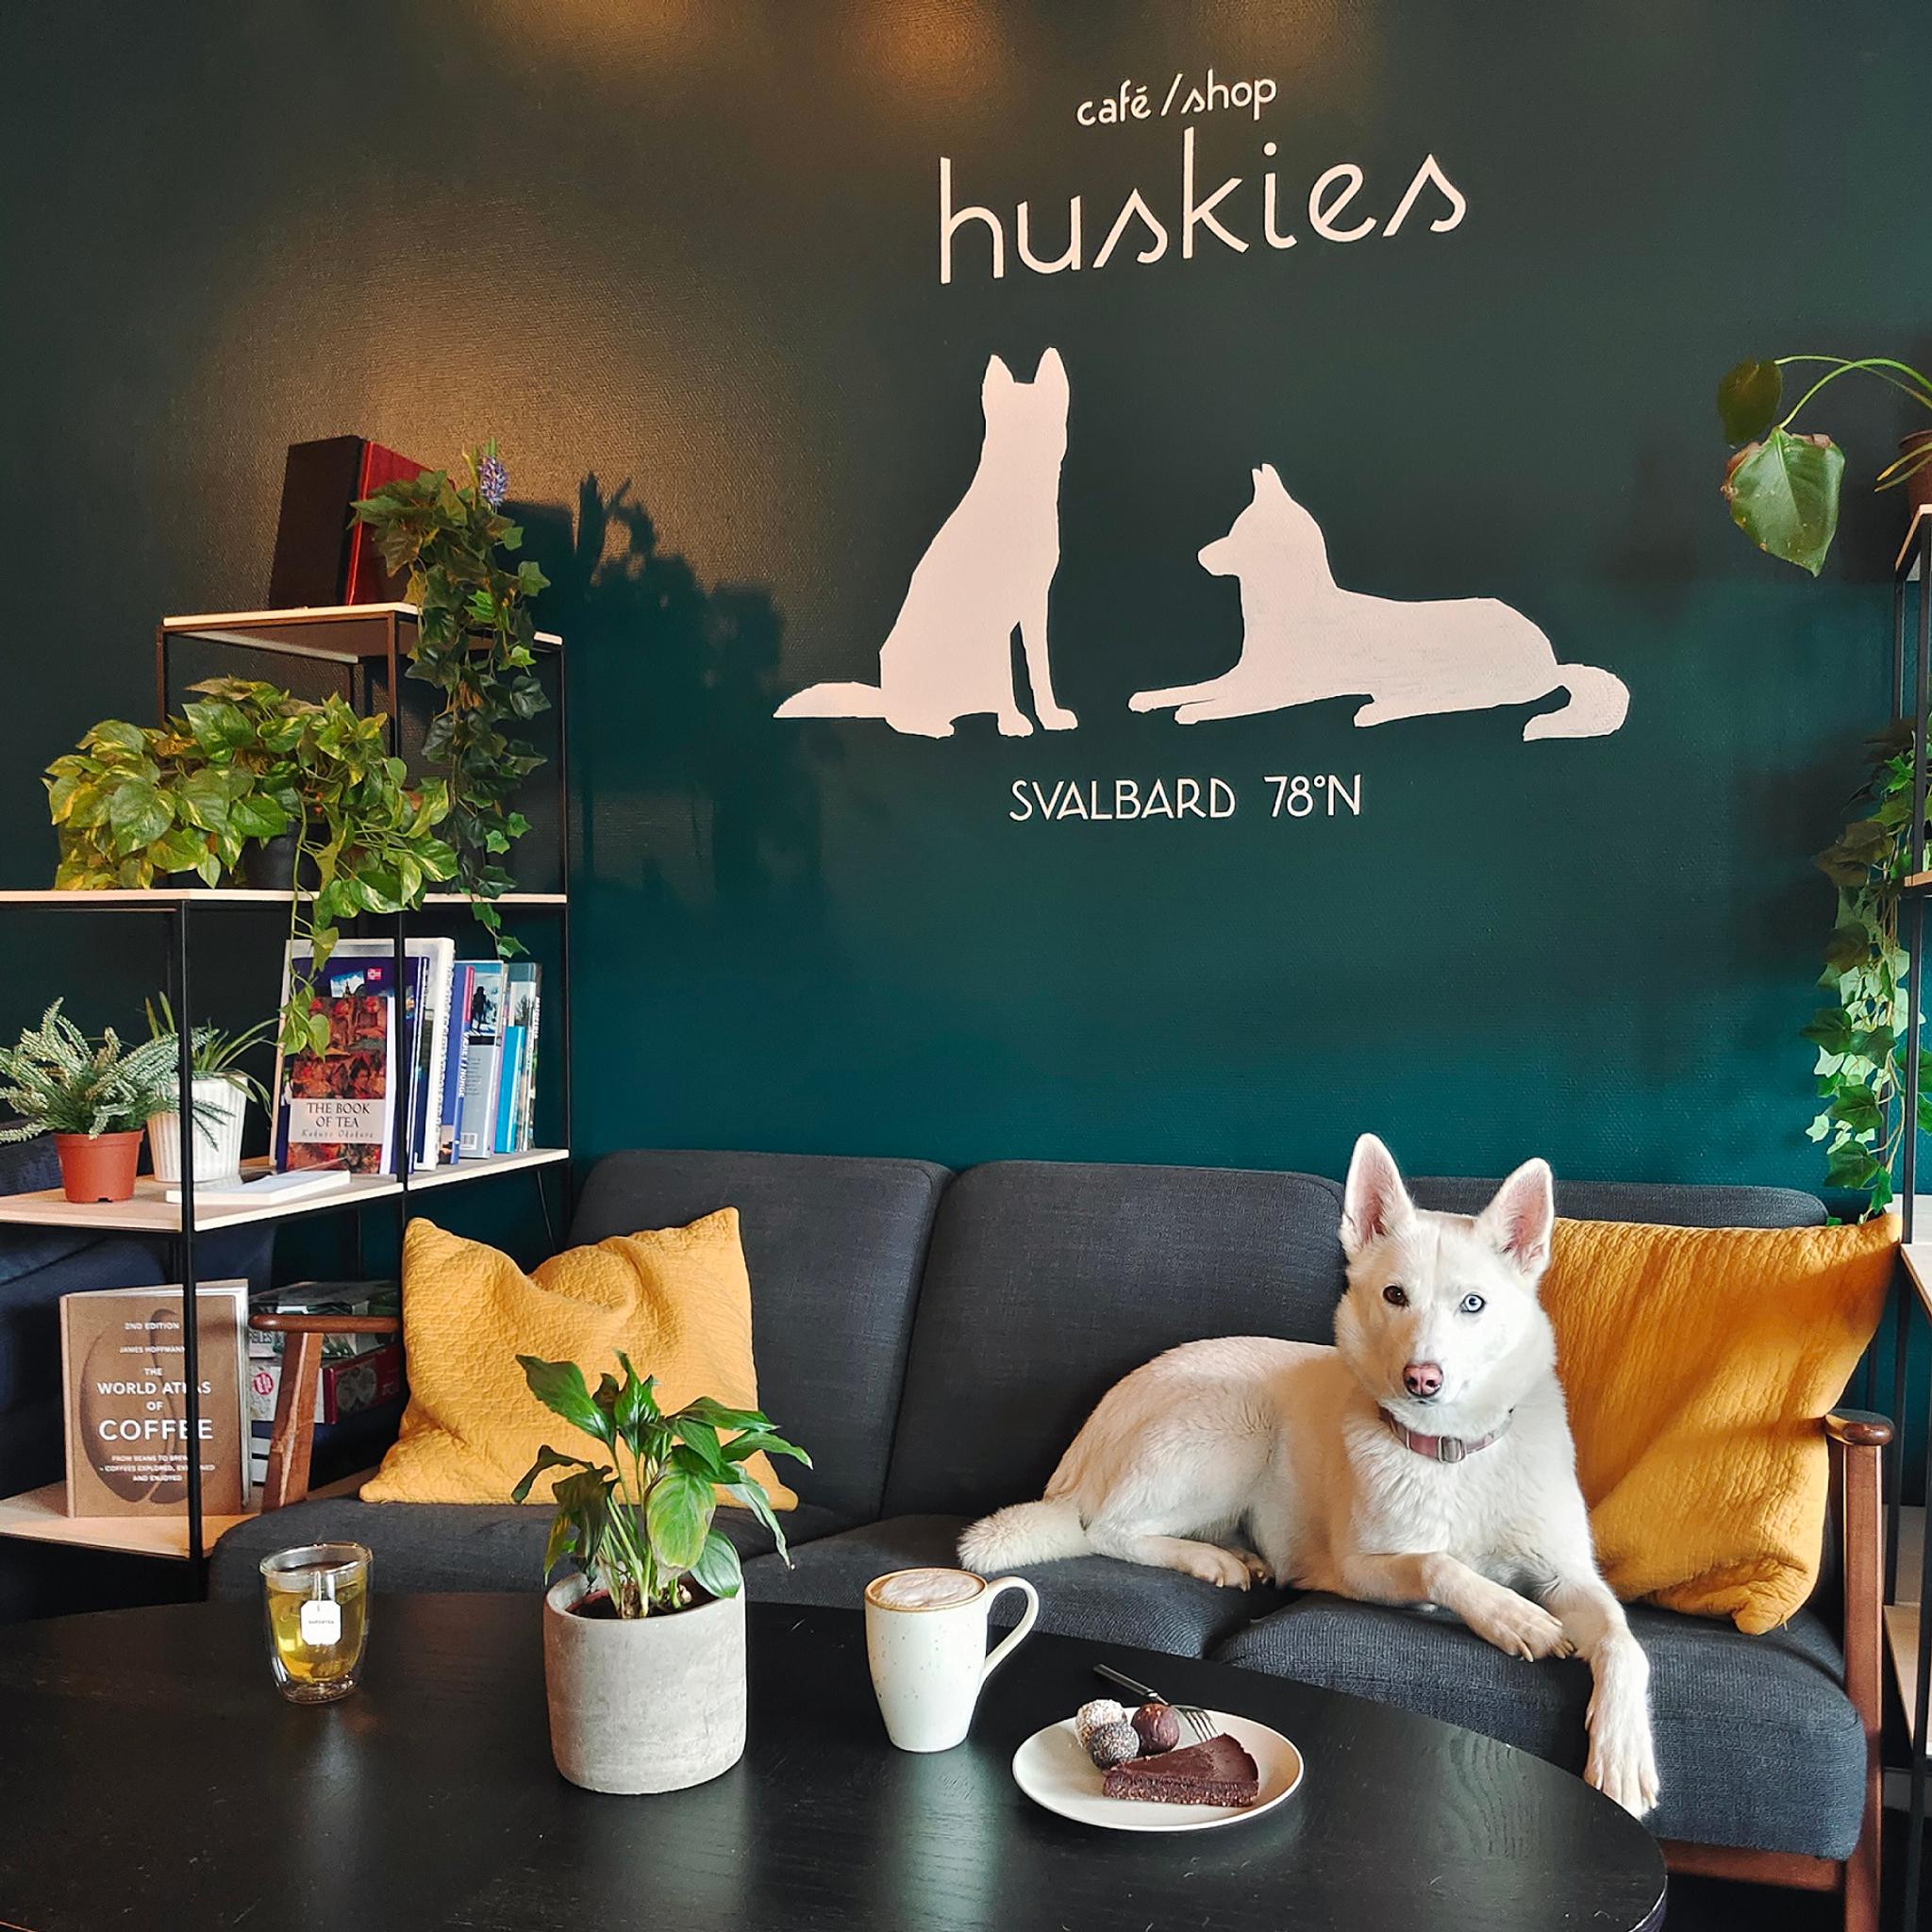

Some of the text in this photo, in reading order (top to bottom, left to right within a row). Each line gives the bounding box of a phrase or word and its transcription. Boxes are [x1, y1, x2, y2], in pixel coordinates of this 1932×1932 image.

[1075, 79, 1152, 126] café
[940, 126, 1467, 284] huskies
[1008, 774, 1361, 822] SVALBARD 78°N
[307, 1102, 371, 1114] THE BOOK
[315, 1115, 359, 1128] OF TEA
[125, 1322, 180, 1330] 2ND EDITION
[120, 1345, 144, 1354] JAMES
[143, 1367, 163, 1376] THE
[96, 1380, 212, 1395] WORLD ATS
[145, 1400, 164, 1411] OF
[98, 1419, 214, 1441] COFFEE
